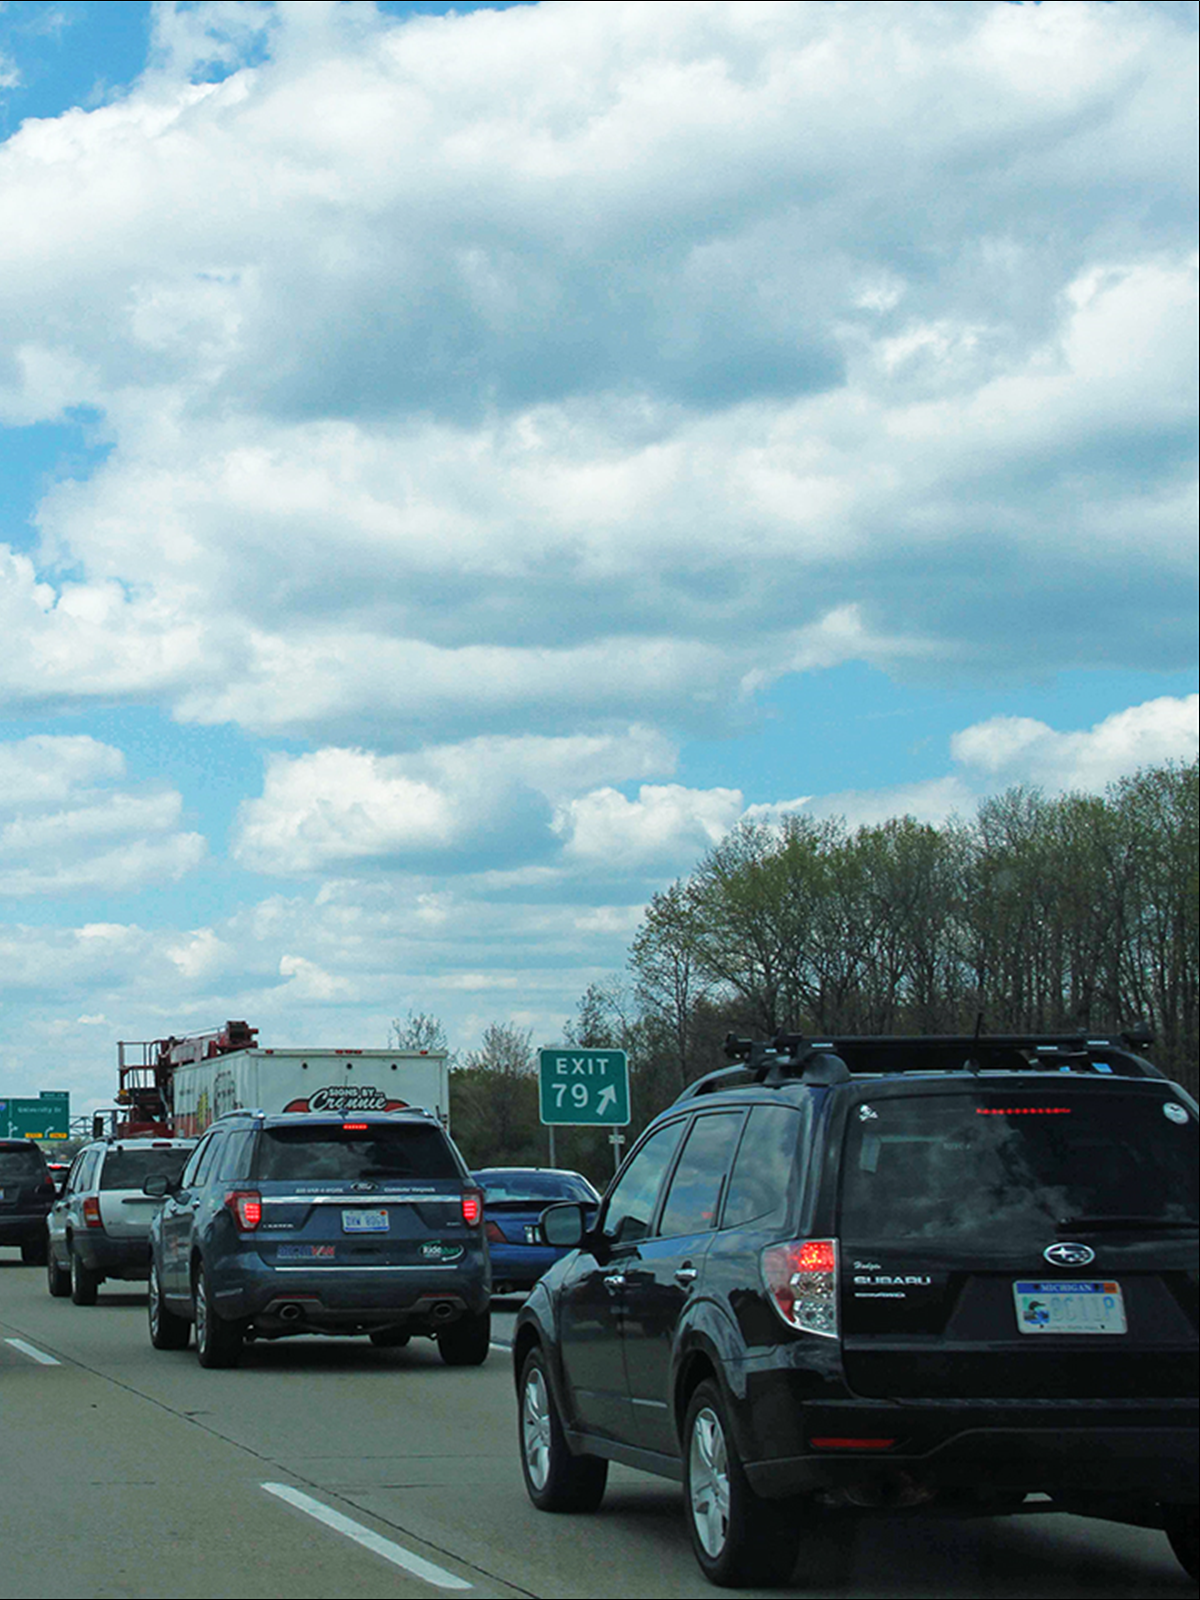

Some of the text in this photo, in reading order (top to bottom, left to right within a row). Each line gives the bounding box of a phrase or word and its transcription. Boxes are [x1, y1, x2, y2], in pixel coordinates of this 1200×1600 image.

[555, 1058, 609, 1075] EXIT
[329, 1088, 358, 1096] SIGNS
[551, 1083, 589, 1108] 79
[853, 1275, 932, 1286] SUBARU
[1040, 1283, 1092, 1292] MICHIGAN
